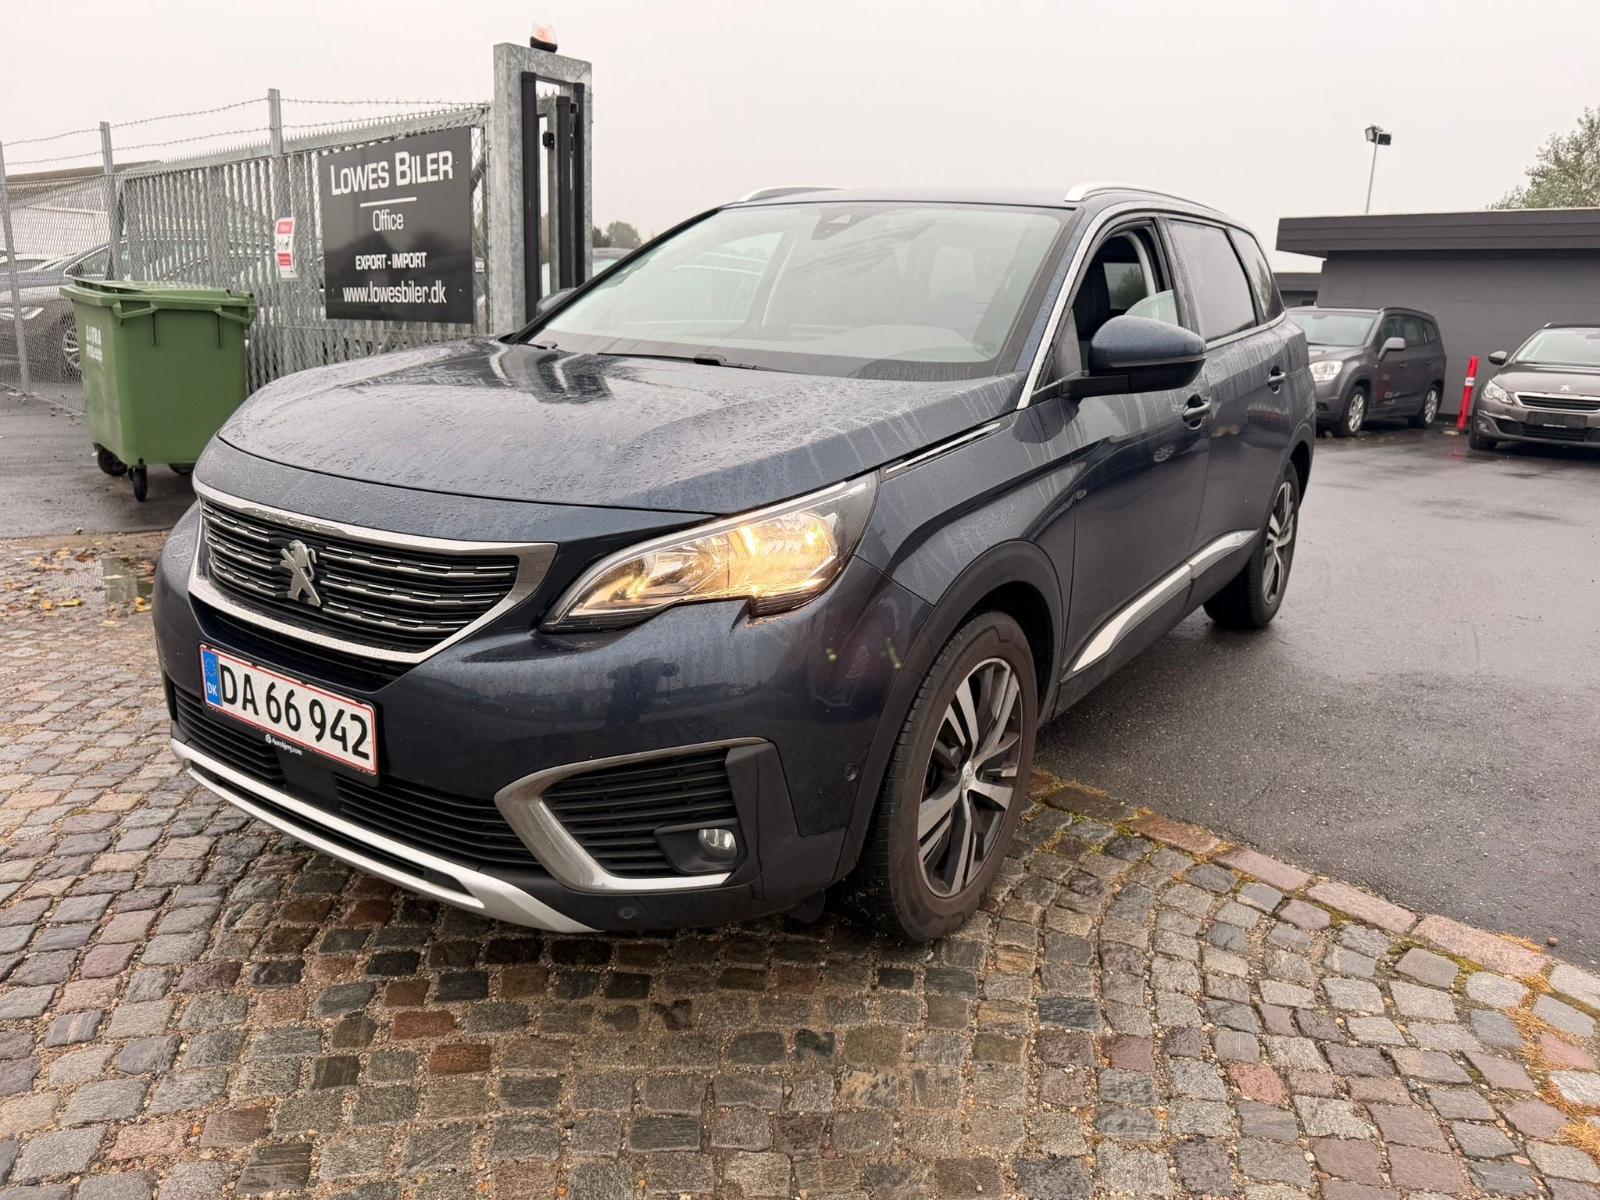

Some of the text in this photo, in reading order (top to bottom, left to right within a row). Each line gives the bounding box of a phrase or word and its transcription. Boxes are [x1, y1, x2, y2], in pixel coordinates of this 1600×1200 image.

[372, 209, 404, 232] Office
[355, 254, 386, 270] EXPORT
[392, 252, 427, 269] IMPORT
[342, 280, 447, 304] www.lowesbiler.dk
[207, 682, 218, 697] DK
[220, 663, 370, 760] DA 66 942
